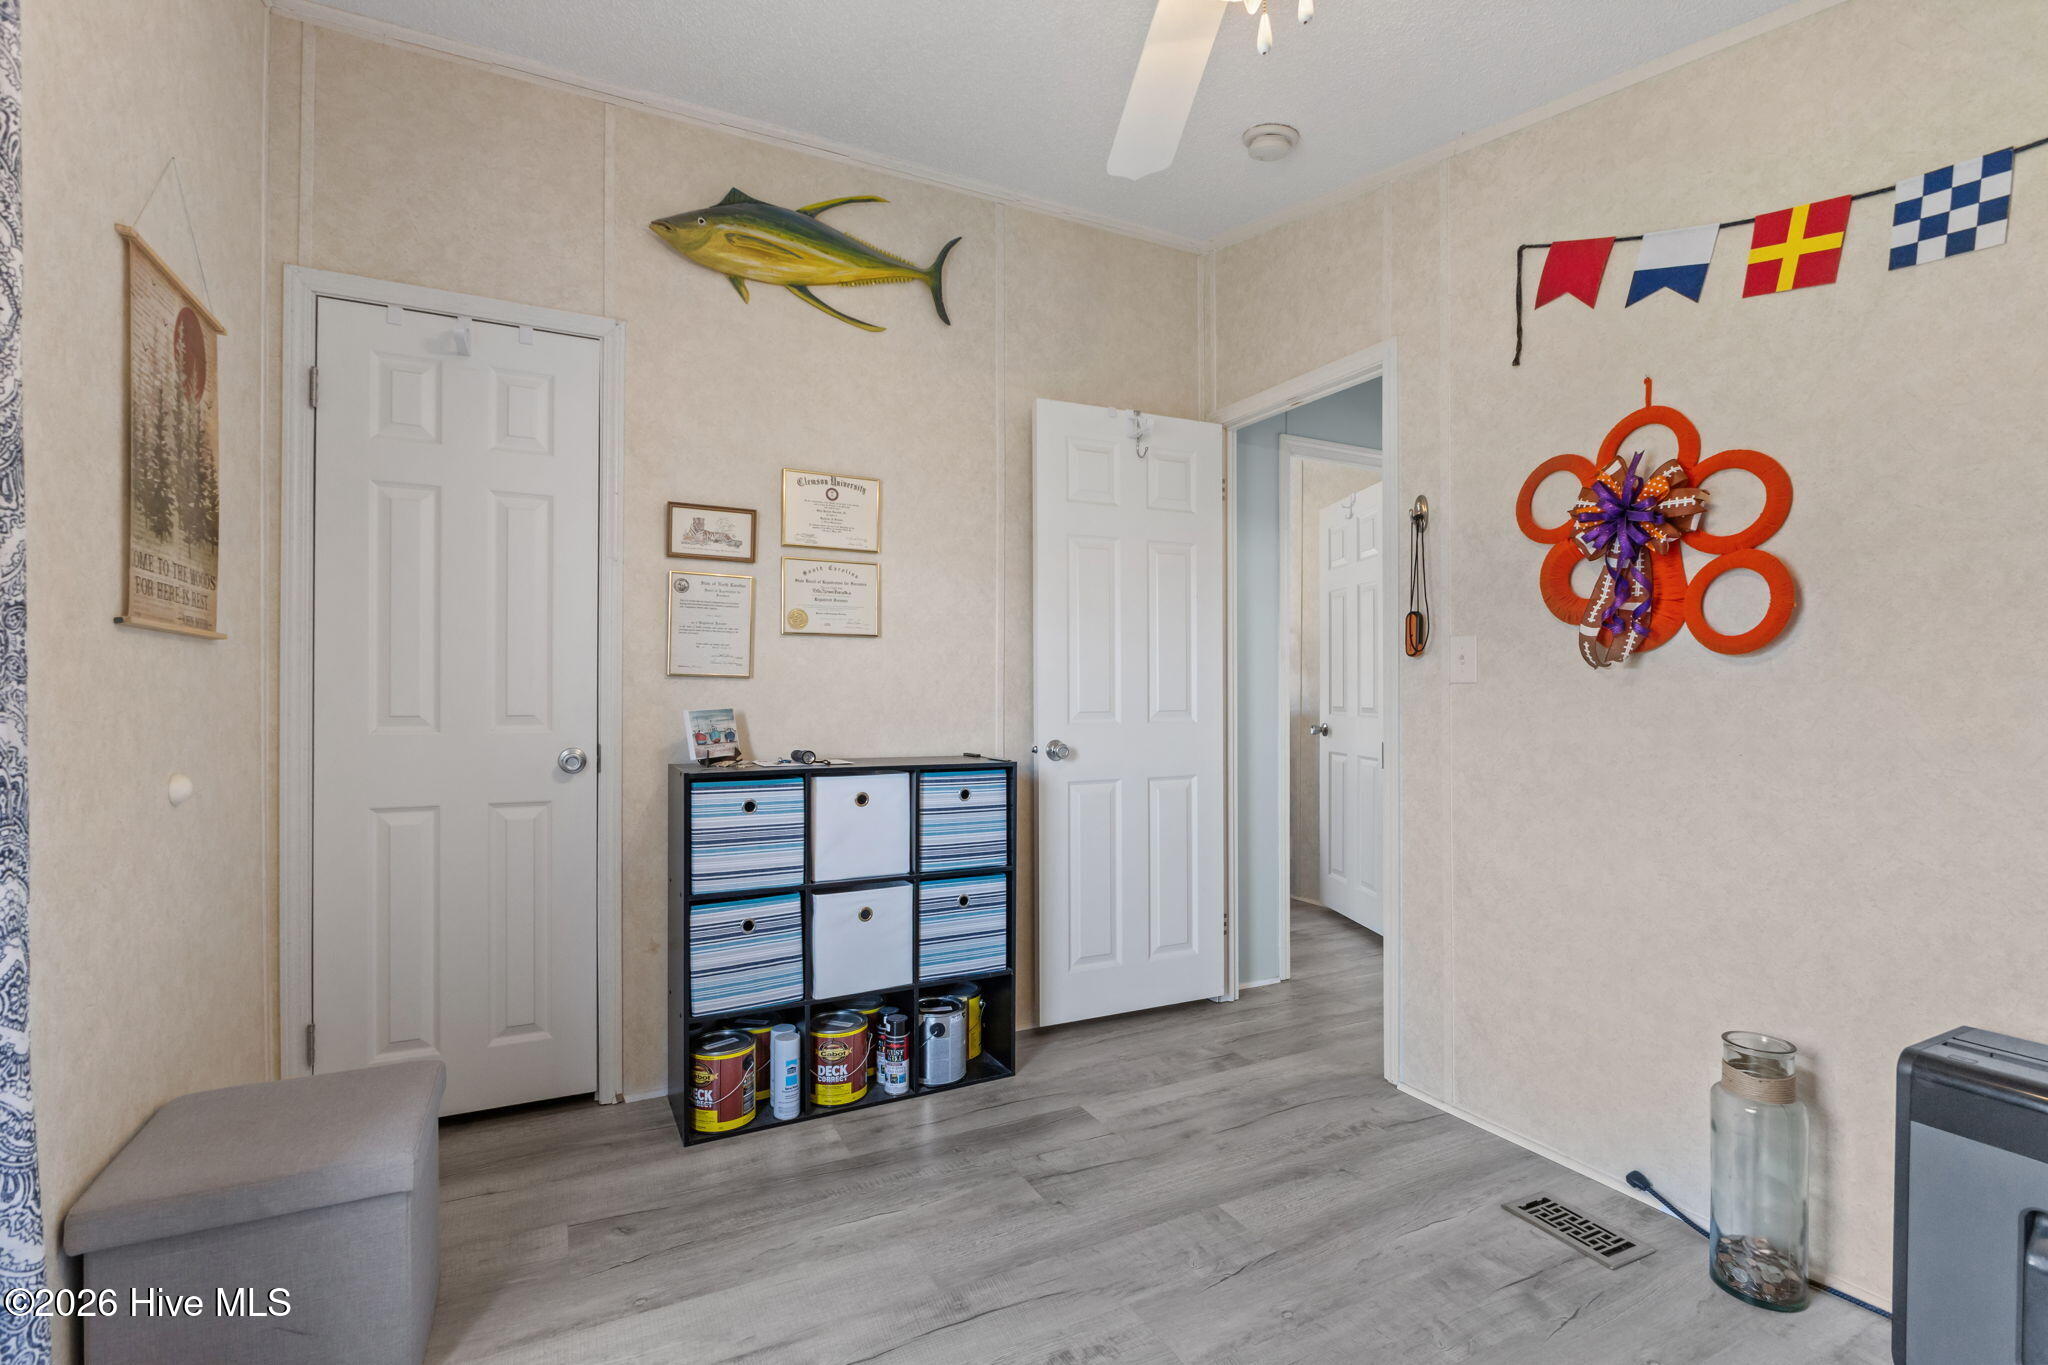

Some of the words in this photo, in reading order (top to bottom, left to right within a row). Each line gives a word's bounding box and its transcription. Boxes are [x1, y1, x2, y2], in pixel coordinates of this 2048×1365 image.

[797, 477, 828, 487] Clemson
[830, 476, 867, 495] University
[133, 550, 154, 572] OME
[157, 557, 170, 576] TO
[172, 562, 188, 582] THE
[135, 575, 154, 597] FOR
[157, 581, 181, 604] HERE
[182, 587, 190, 604] IS
[191, 591, 209, 611] REST
[817, 1064, 848, 1076] DECK
[818, 1075, 848, 1083] CORRECT
